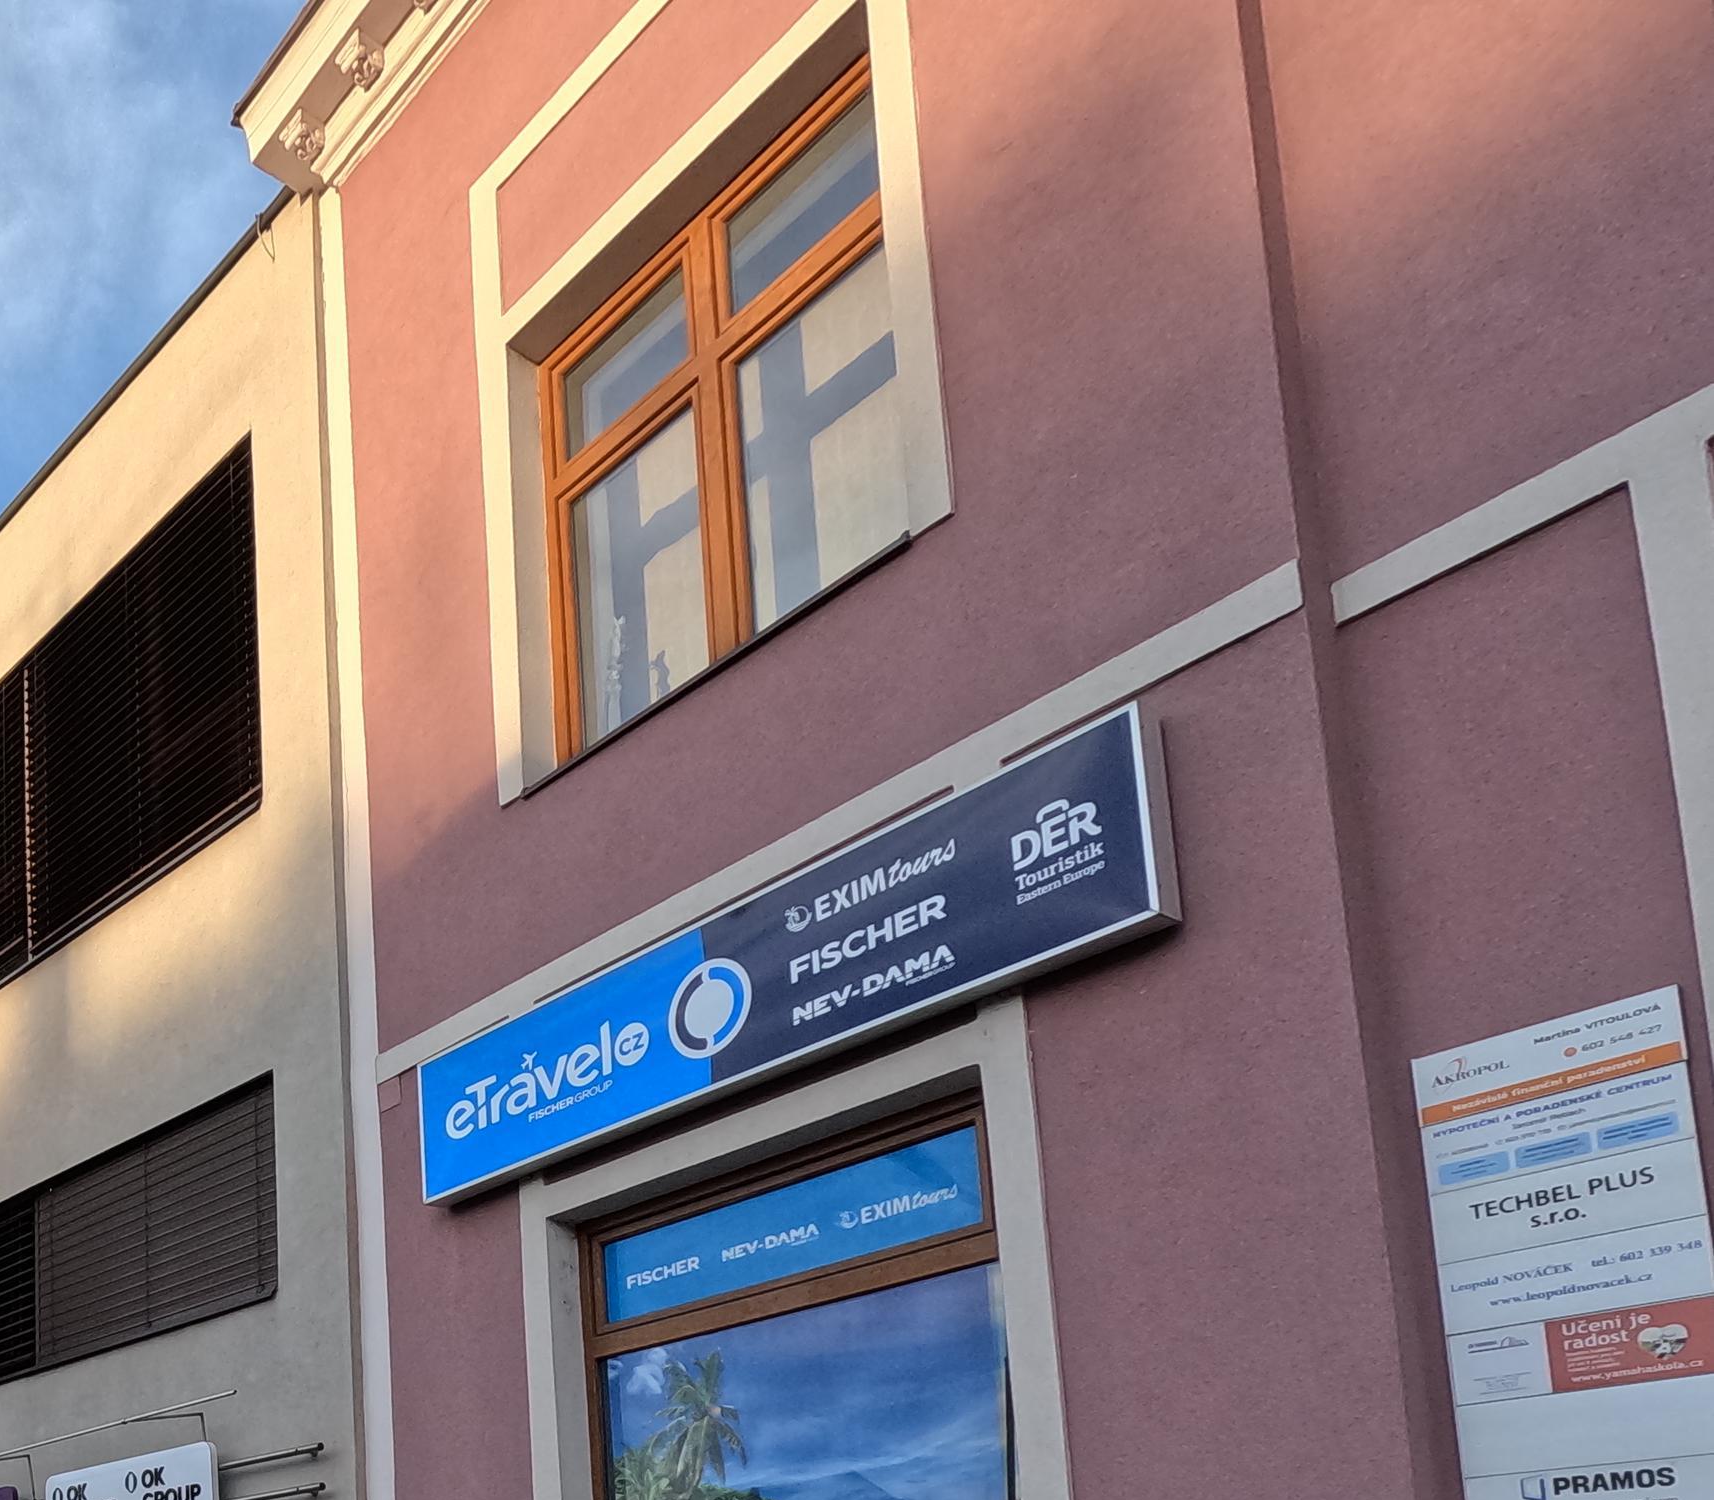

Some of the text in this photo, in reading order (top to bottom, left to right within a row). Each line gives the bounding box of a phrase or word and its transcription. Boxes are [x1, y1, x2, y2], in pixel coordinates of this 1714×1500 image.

[1010, 800, 1103, 871] DER
[1015, 839, 1104, 891] Touristik
[1016, 859, 1106, 906] Eastern Europe
[789, 894, 947, 984] FISCHER
[792, 944, 956, 1027] NEV-DAMA
[1534, 1027, 1581, 1045] Martina
[1581, 1039, 1605, 1053] 602
[1638, 1023, 1663, 1037] 427
[1431, 1060, 1511, 1088] AKROPOL
[1515, 1089, 1603, 1119] PORADENSKÉ
[1606, 1073, 1673, 1096] CENTRUM
[1469, 1166, 1655, 1220] TECHBEL PLUS
[1530, 1208, 1587, 1228] s.r.o.
[626, 1256, 700, 1291] FISCHER
[721, 1223, 820, 1263] NEV-DAMA
[1450, 1277, 1500, 1293] Leopold
[1502, 1262, 1574, 1284] NOVÁČEK
[1619, 1250, 1644, 1262] 602
[1649, 1245, 1673, 1258] 339
[1677, 1239, 1703, 1254] 348
[1489, 1272, 1654, 1307] www.leopoldnovacek.cz
[1629, 1311, 1652, 1330] je
[1563, 1329, 1631, 1351] radost
[1570, 1359, 1704, 1384] www.yamahaskola.cz
[141, 1466, 165, 1489] OK
[1552, 1467, 1676, 1496] PRAMOS
